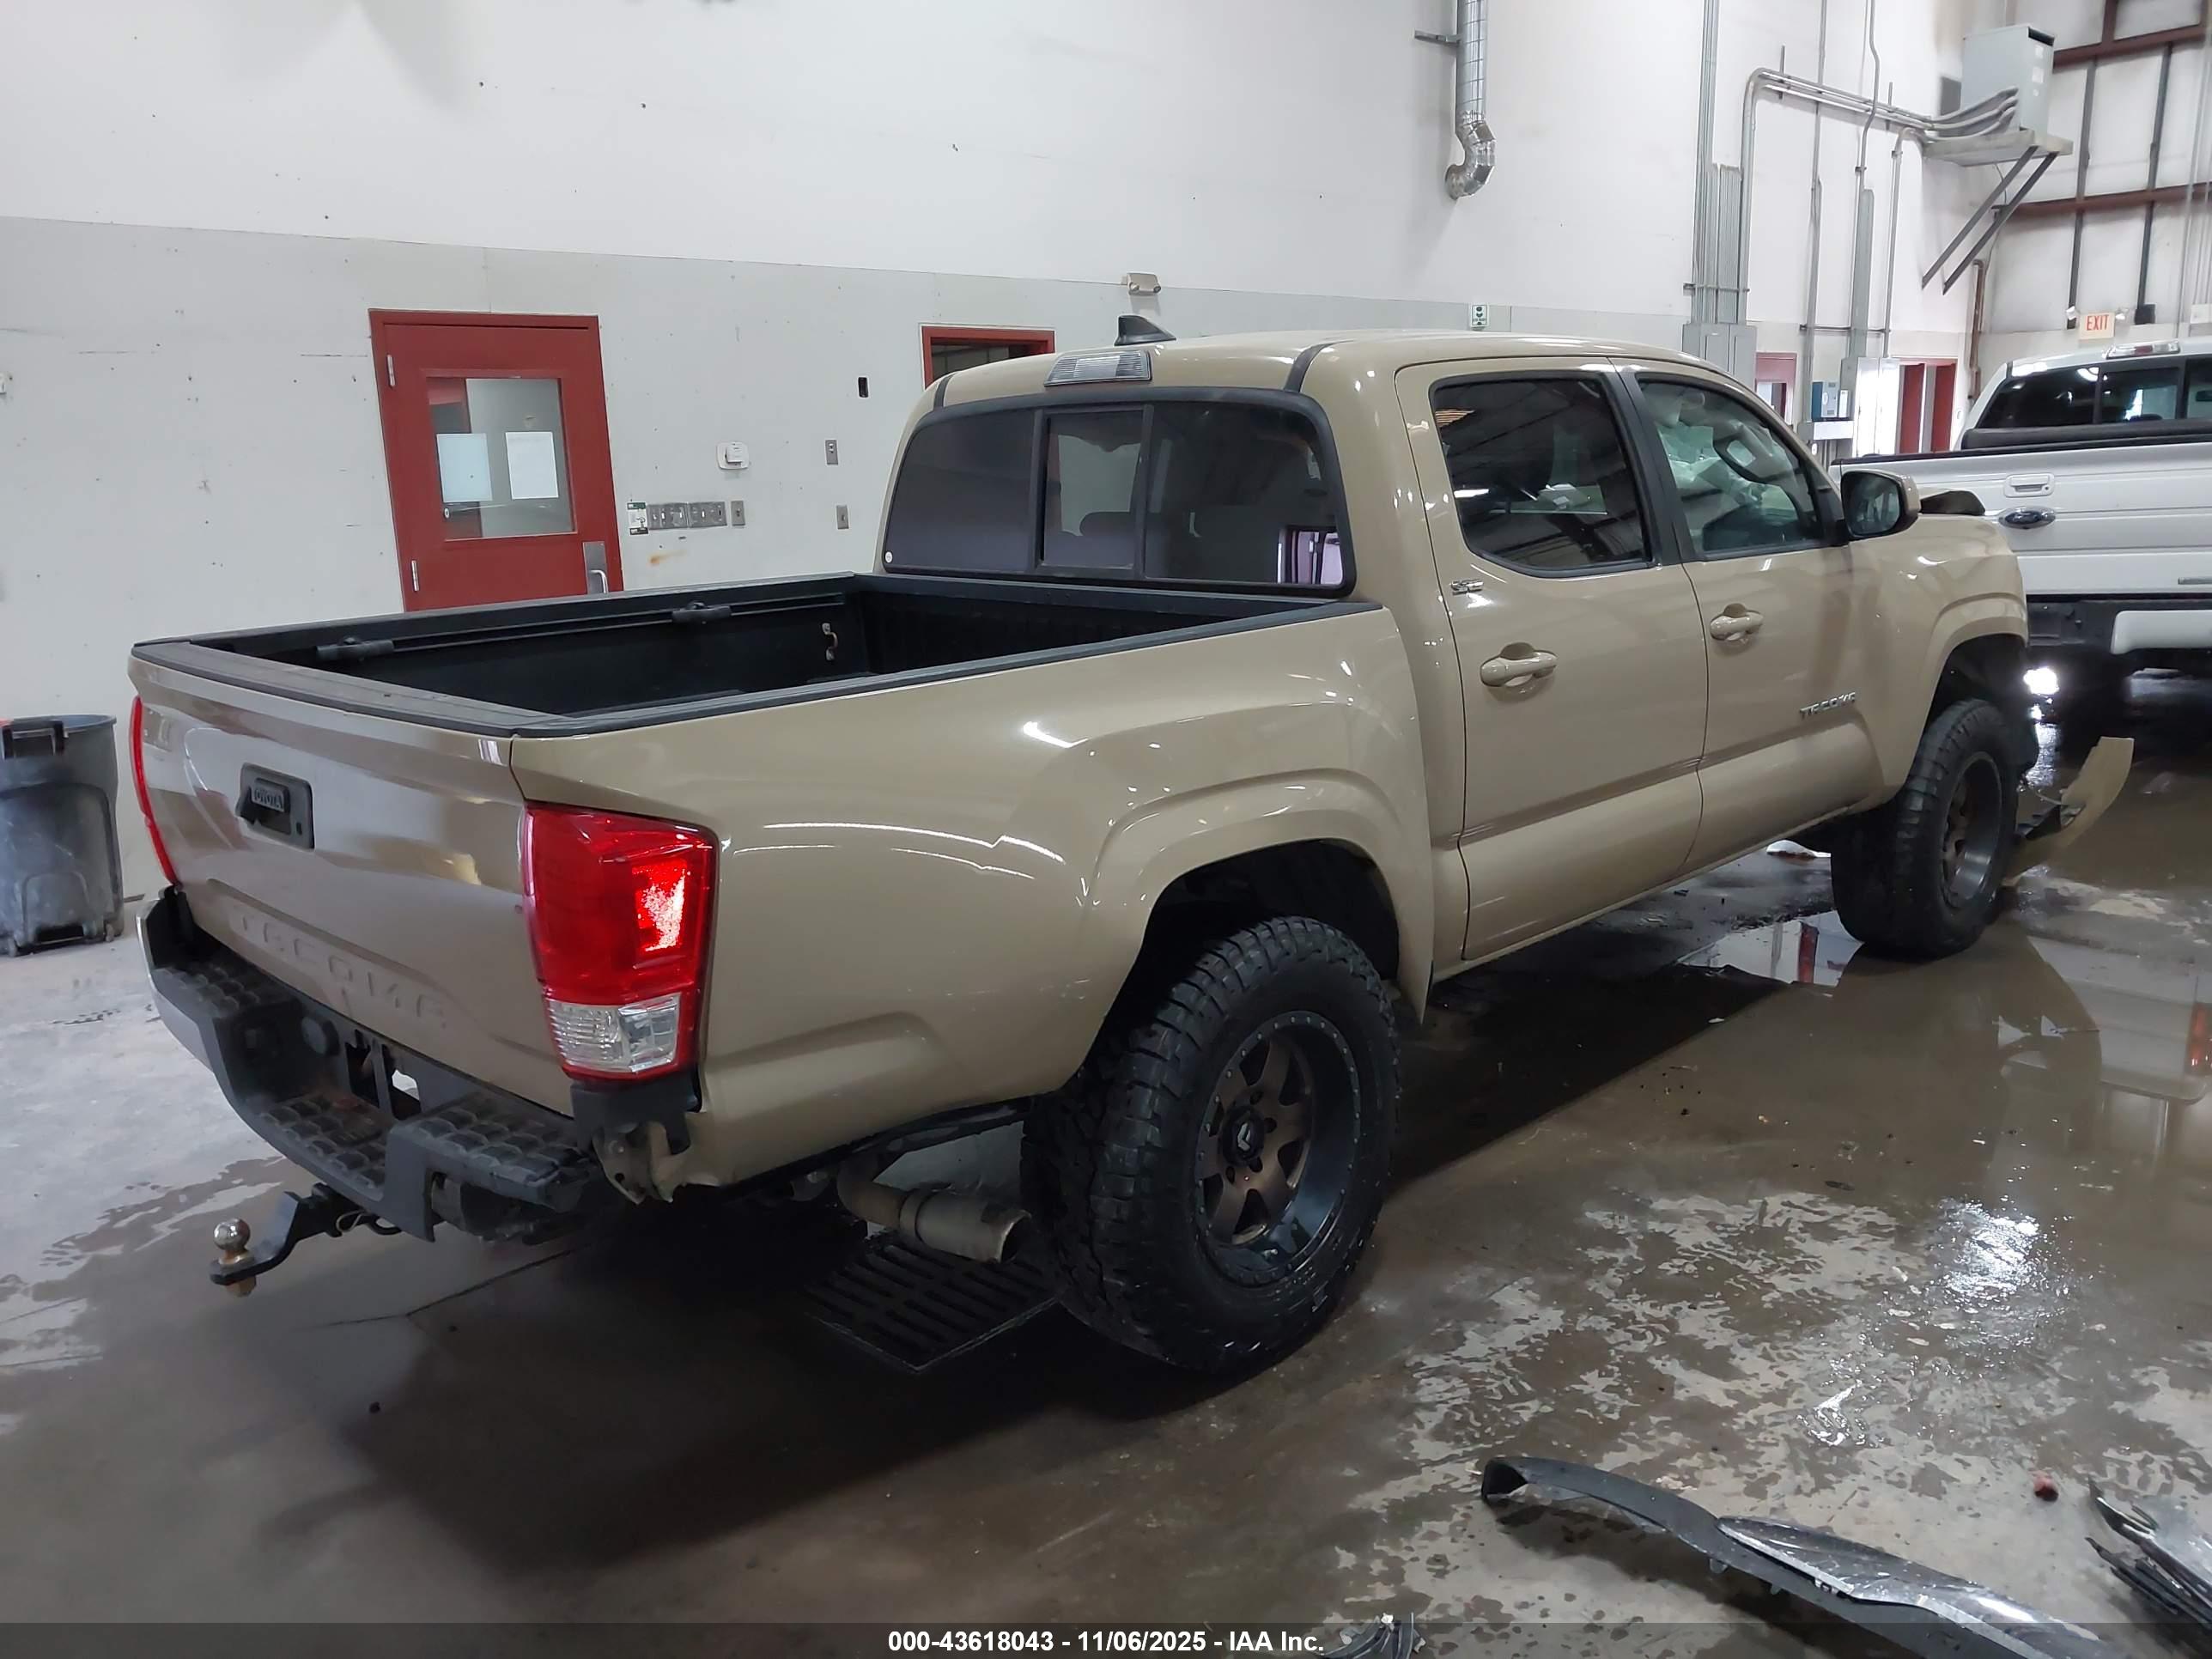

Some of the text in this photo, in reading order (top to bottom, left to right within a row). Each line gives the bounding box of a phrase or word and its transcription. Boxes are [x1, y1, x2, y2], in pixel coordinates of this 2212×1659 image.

[2087, 314, 2109, 331] EXIT
[1799, 691, 1856, 719] TACOMA
[253, 787, 284, 810] TOYOTA
[234, 910, 447, 1029] TACOMA
